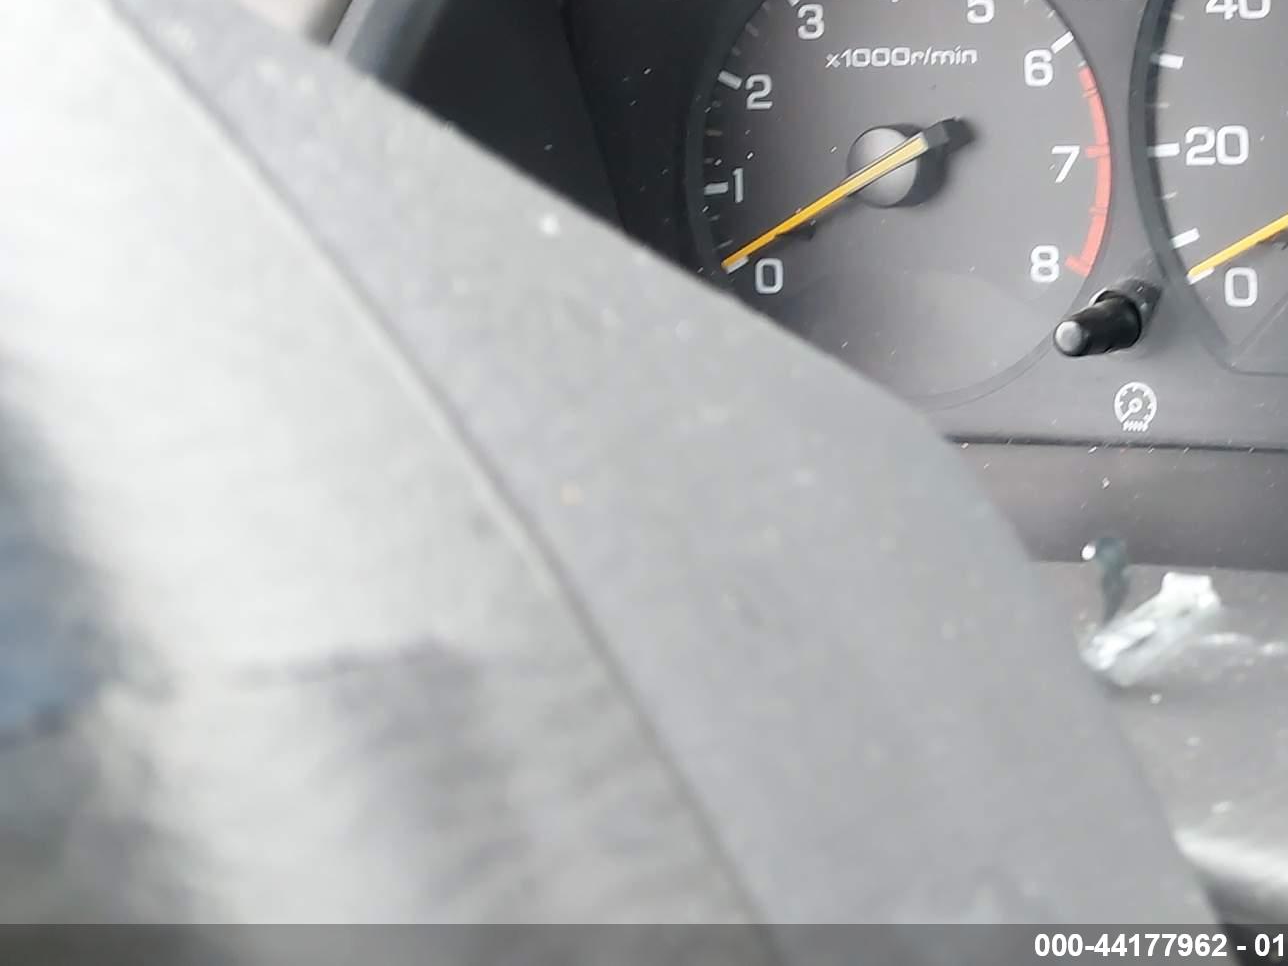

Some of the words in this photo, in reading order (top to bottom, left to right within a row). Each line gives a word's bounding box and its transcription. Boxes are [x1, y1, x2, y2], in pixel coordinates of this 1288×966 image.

[797, 4, 824, 40] 3
[826, 45, 977, 68] x1000r/min
[1023, 49, 1053, 87] 6
[745, 75, 773, 110] 2
[1051, 145, 1081, 183] 7
[1185, 125, 1249, 166] 20
[733, 168, 744, 203] 1
[755, 258, 784, 294] 0
[1030, 245, 1059, 283] 8
[1224, 267, 1258, 307] 0
